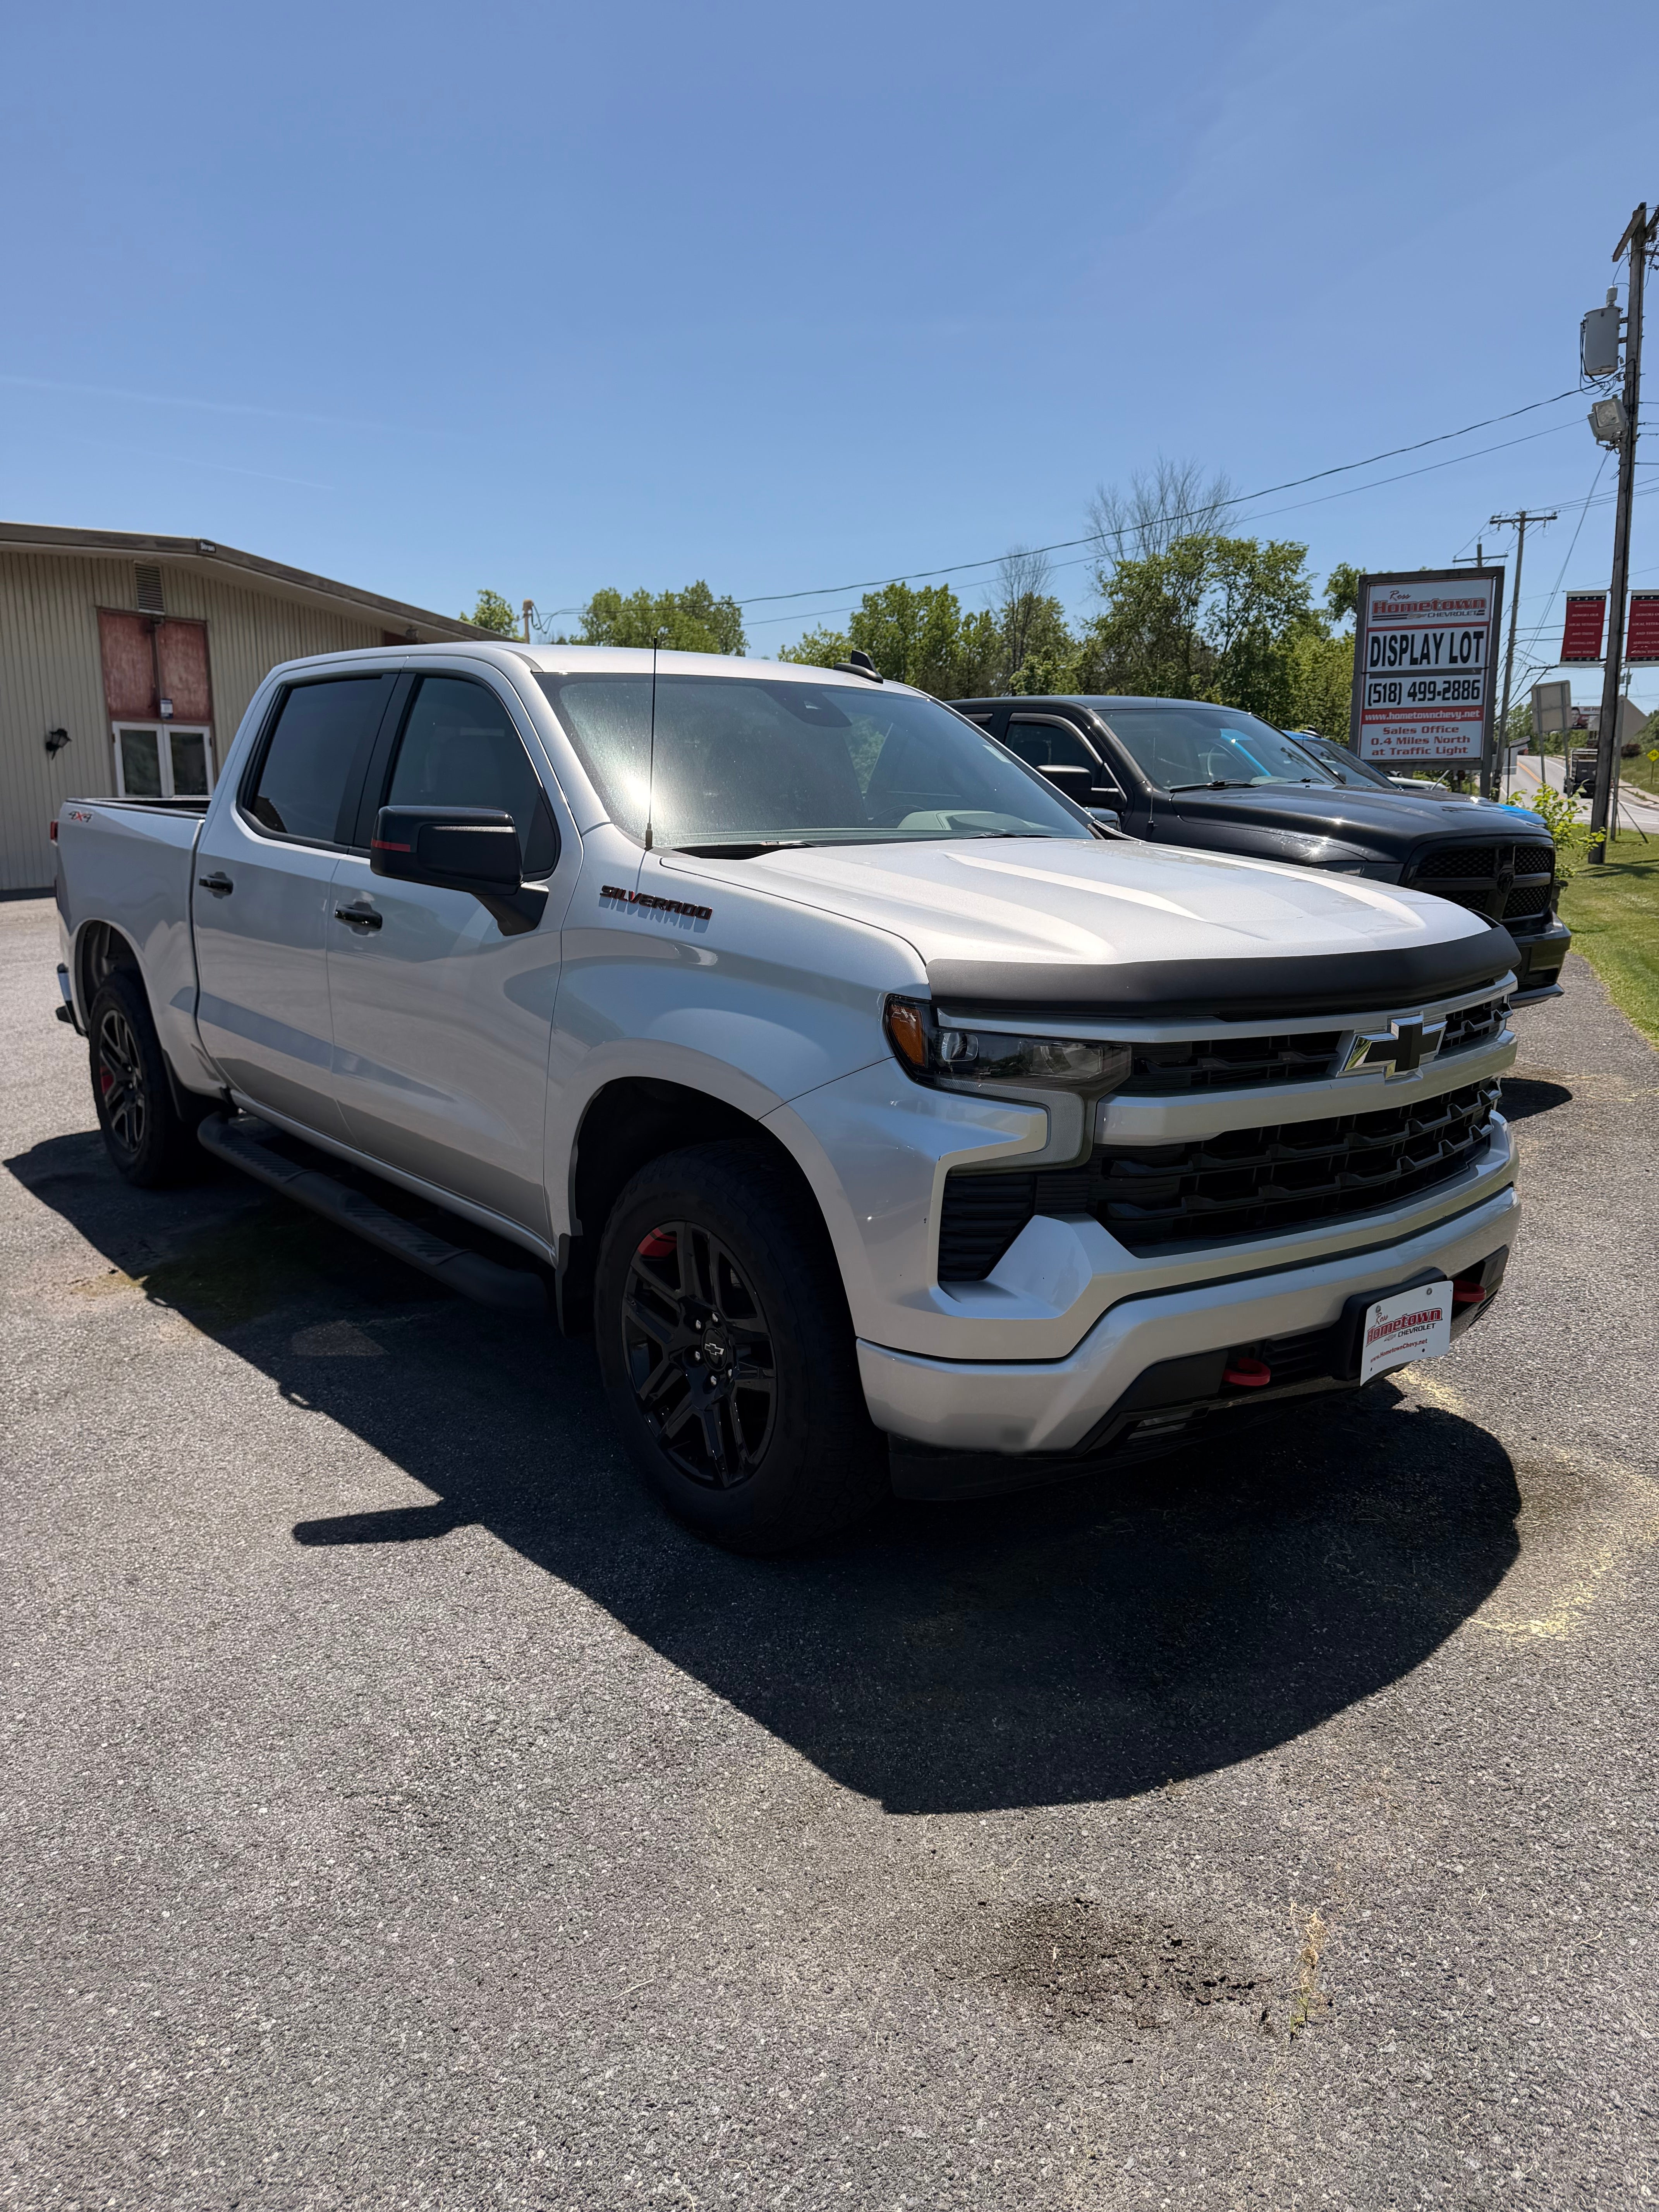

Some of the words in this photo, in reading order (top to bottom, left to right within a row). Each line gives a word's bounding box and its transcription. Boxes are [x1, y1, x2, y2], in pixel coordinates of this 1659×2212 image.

[1389, 590, 1411, 601] Ross
[1372, 598, 1487, 615] Hometown
[1427, 610, 1477, 618] CHEVROLET
[1370, 632, 1444, 667] DISPLAY
[1449, 631, 1484, 664] LOT
[1368, 682, 1402, 706] (518)
[1407, 679, 1481, 702] 499-2886
[1365, 710, 1480, 720] www.hometownchevy.net
[1383, 726, 1417, 735] Sales
[1421, 725, 1459, 733] Office
[1389, 747, 1431, 755] Traffic
[1436, 746, 1468, 756] Light
[599, 885, 713, 920] SILVERADO
[1365, 1307, 1443, 1348] Hometown
[1398, 1323, 1436, 1337] CHEVROLET
[1370, 1338, 1428, 1363] www.HometownChevy.net
